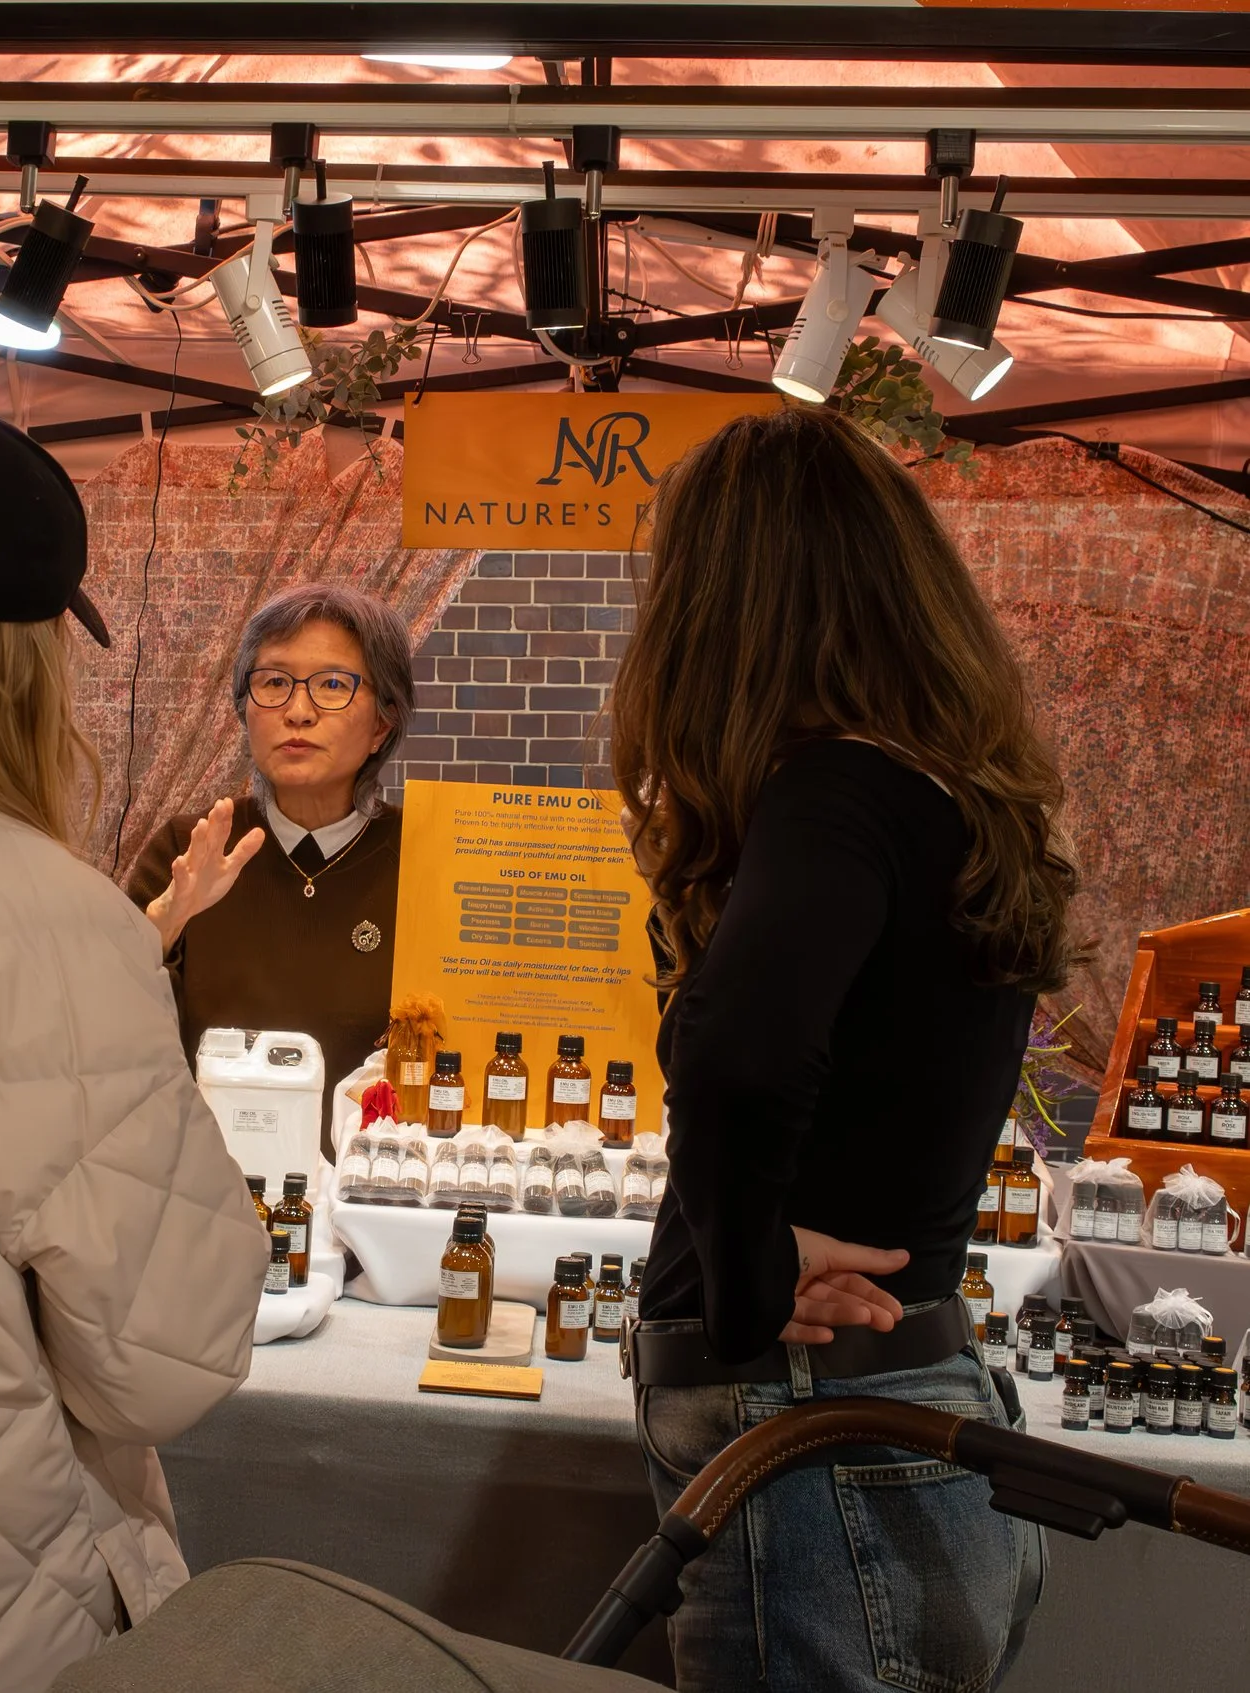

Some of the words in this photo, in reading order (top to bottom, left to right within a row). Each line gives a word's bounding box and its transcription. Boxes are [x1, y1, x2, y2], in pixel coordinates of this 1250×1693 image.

[425, 502, 612, 526] NATURE'S
[493, 792, 532, 806] PURE
[538, 795, 571, 808] EMU
[577, 797, 602, 810] OIL
[505, 840, 556, 849] unsurpassed
[557, 844, 599, 853] nourishing
[455, 848, 492, 857] providing
[523, 851, 556, 859] youthful
[500, 869, 525, 878] USED
[545, 872, 566, 880] EMU
[524, 962, 567, 970] moisturizer
[602, 967, 615, 975] dry
[616, 968, 631, 976] lips
[534, 973, 569, 982] beautiful,
